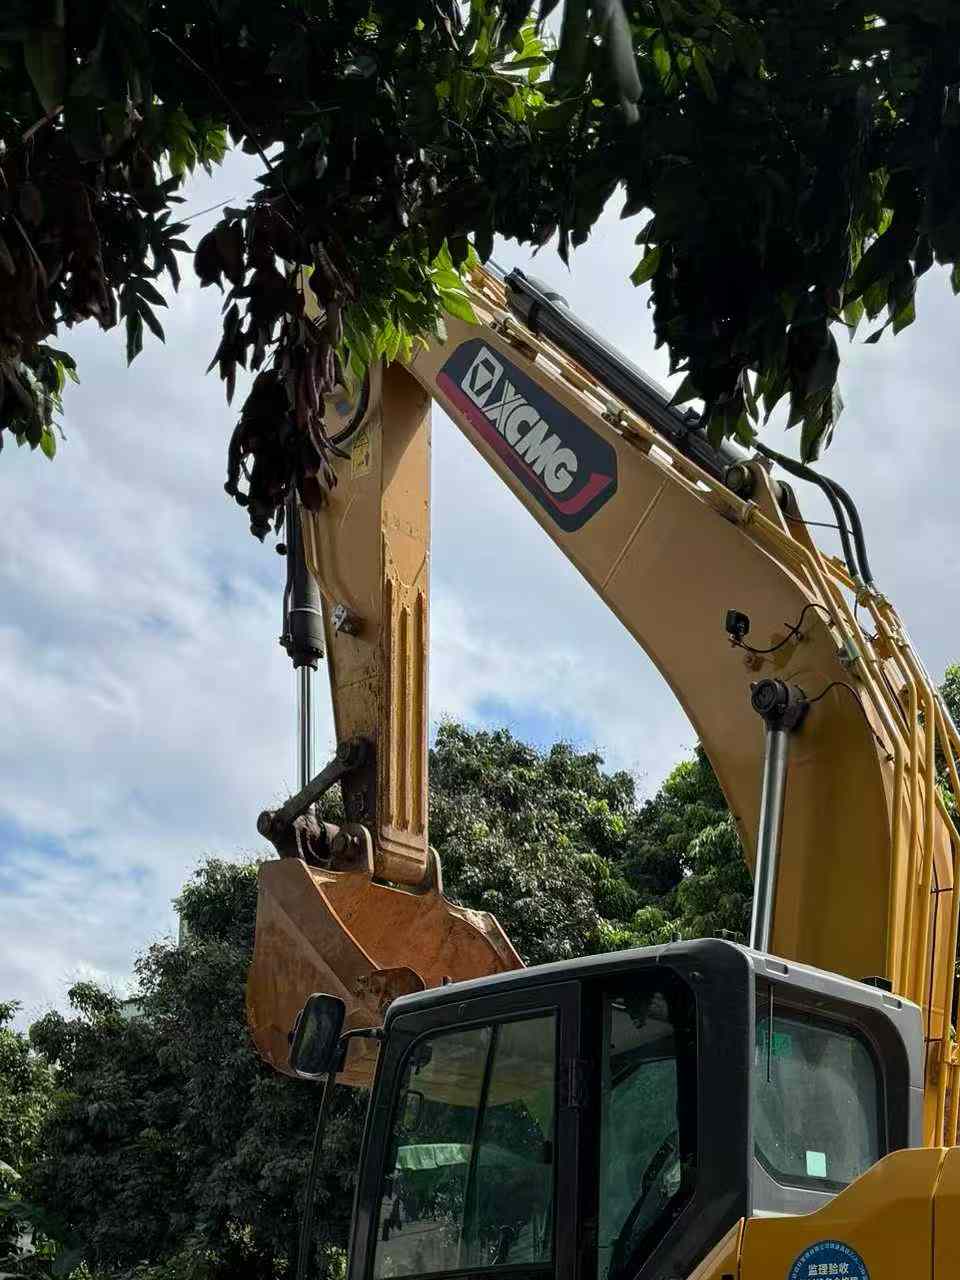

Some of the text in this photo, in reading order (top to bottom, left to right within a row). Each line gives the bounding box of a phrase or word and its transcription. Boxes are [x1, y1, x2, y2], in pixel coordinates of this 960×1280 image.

[482, 380, 578, 493] XCMG
[808, 1262, 849, 1276] 监理验收
